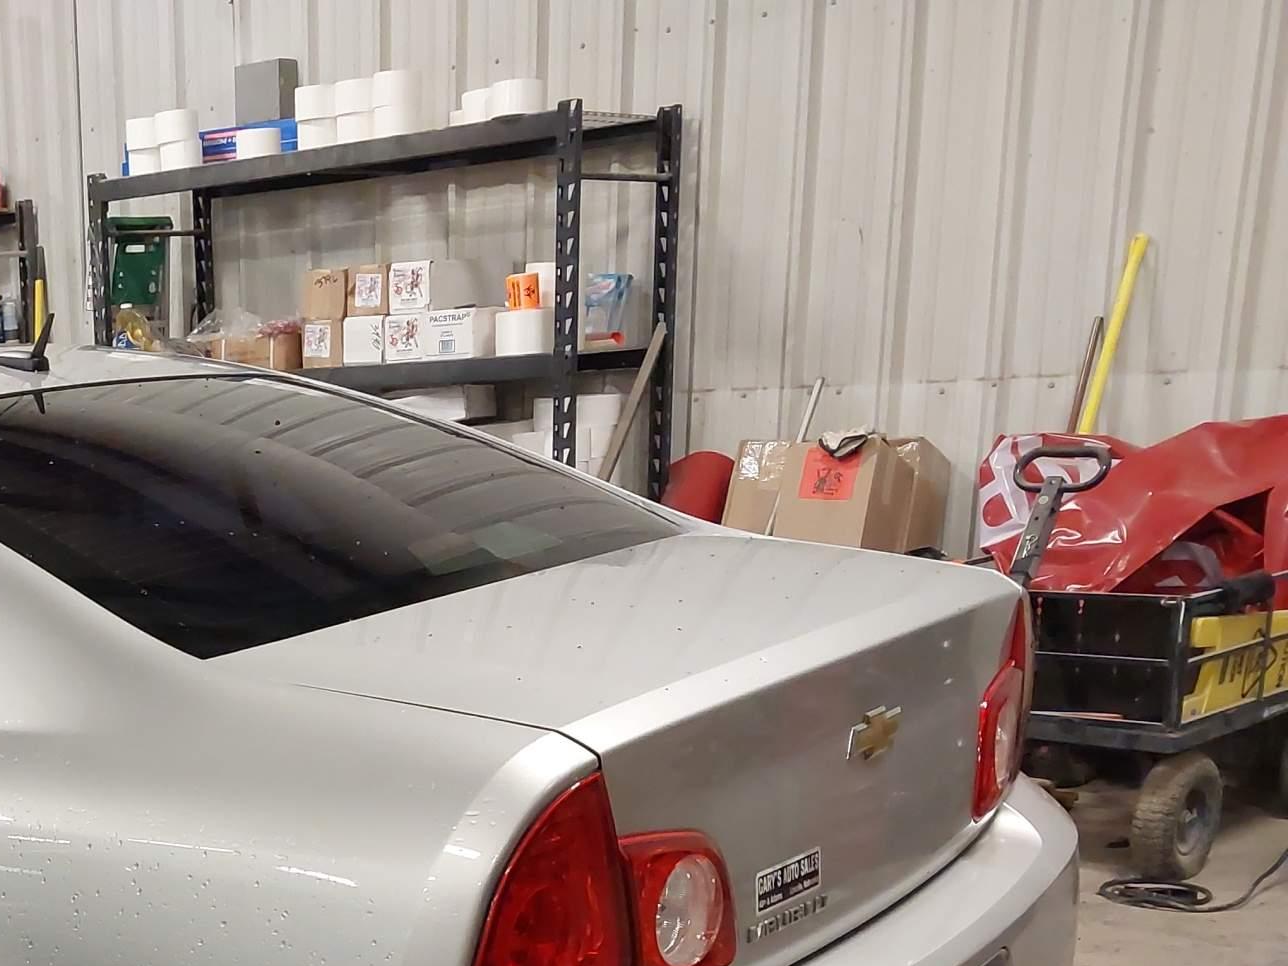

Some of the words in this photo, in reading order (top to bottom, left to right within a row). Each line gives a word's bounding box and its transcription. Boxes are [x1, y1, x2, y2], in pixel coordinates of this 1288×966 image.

[759, 869, 783, 895] GARY'S
[783, 863, 800, 884] AUTO
[800, 853, 818, 877] SALES
